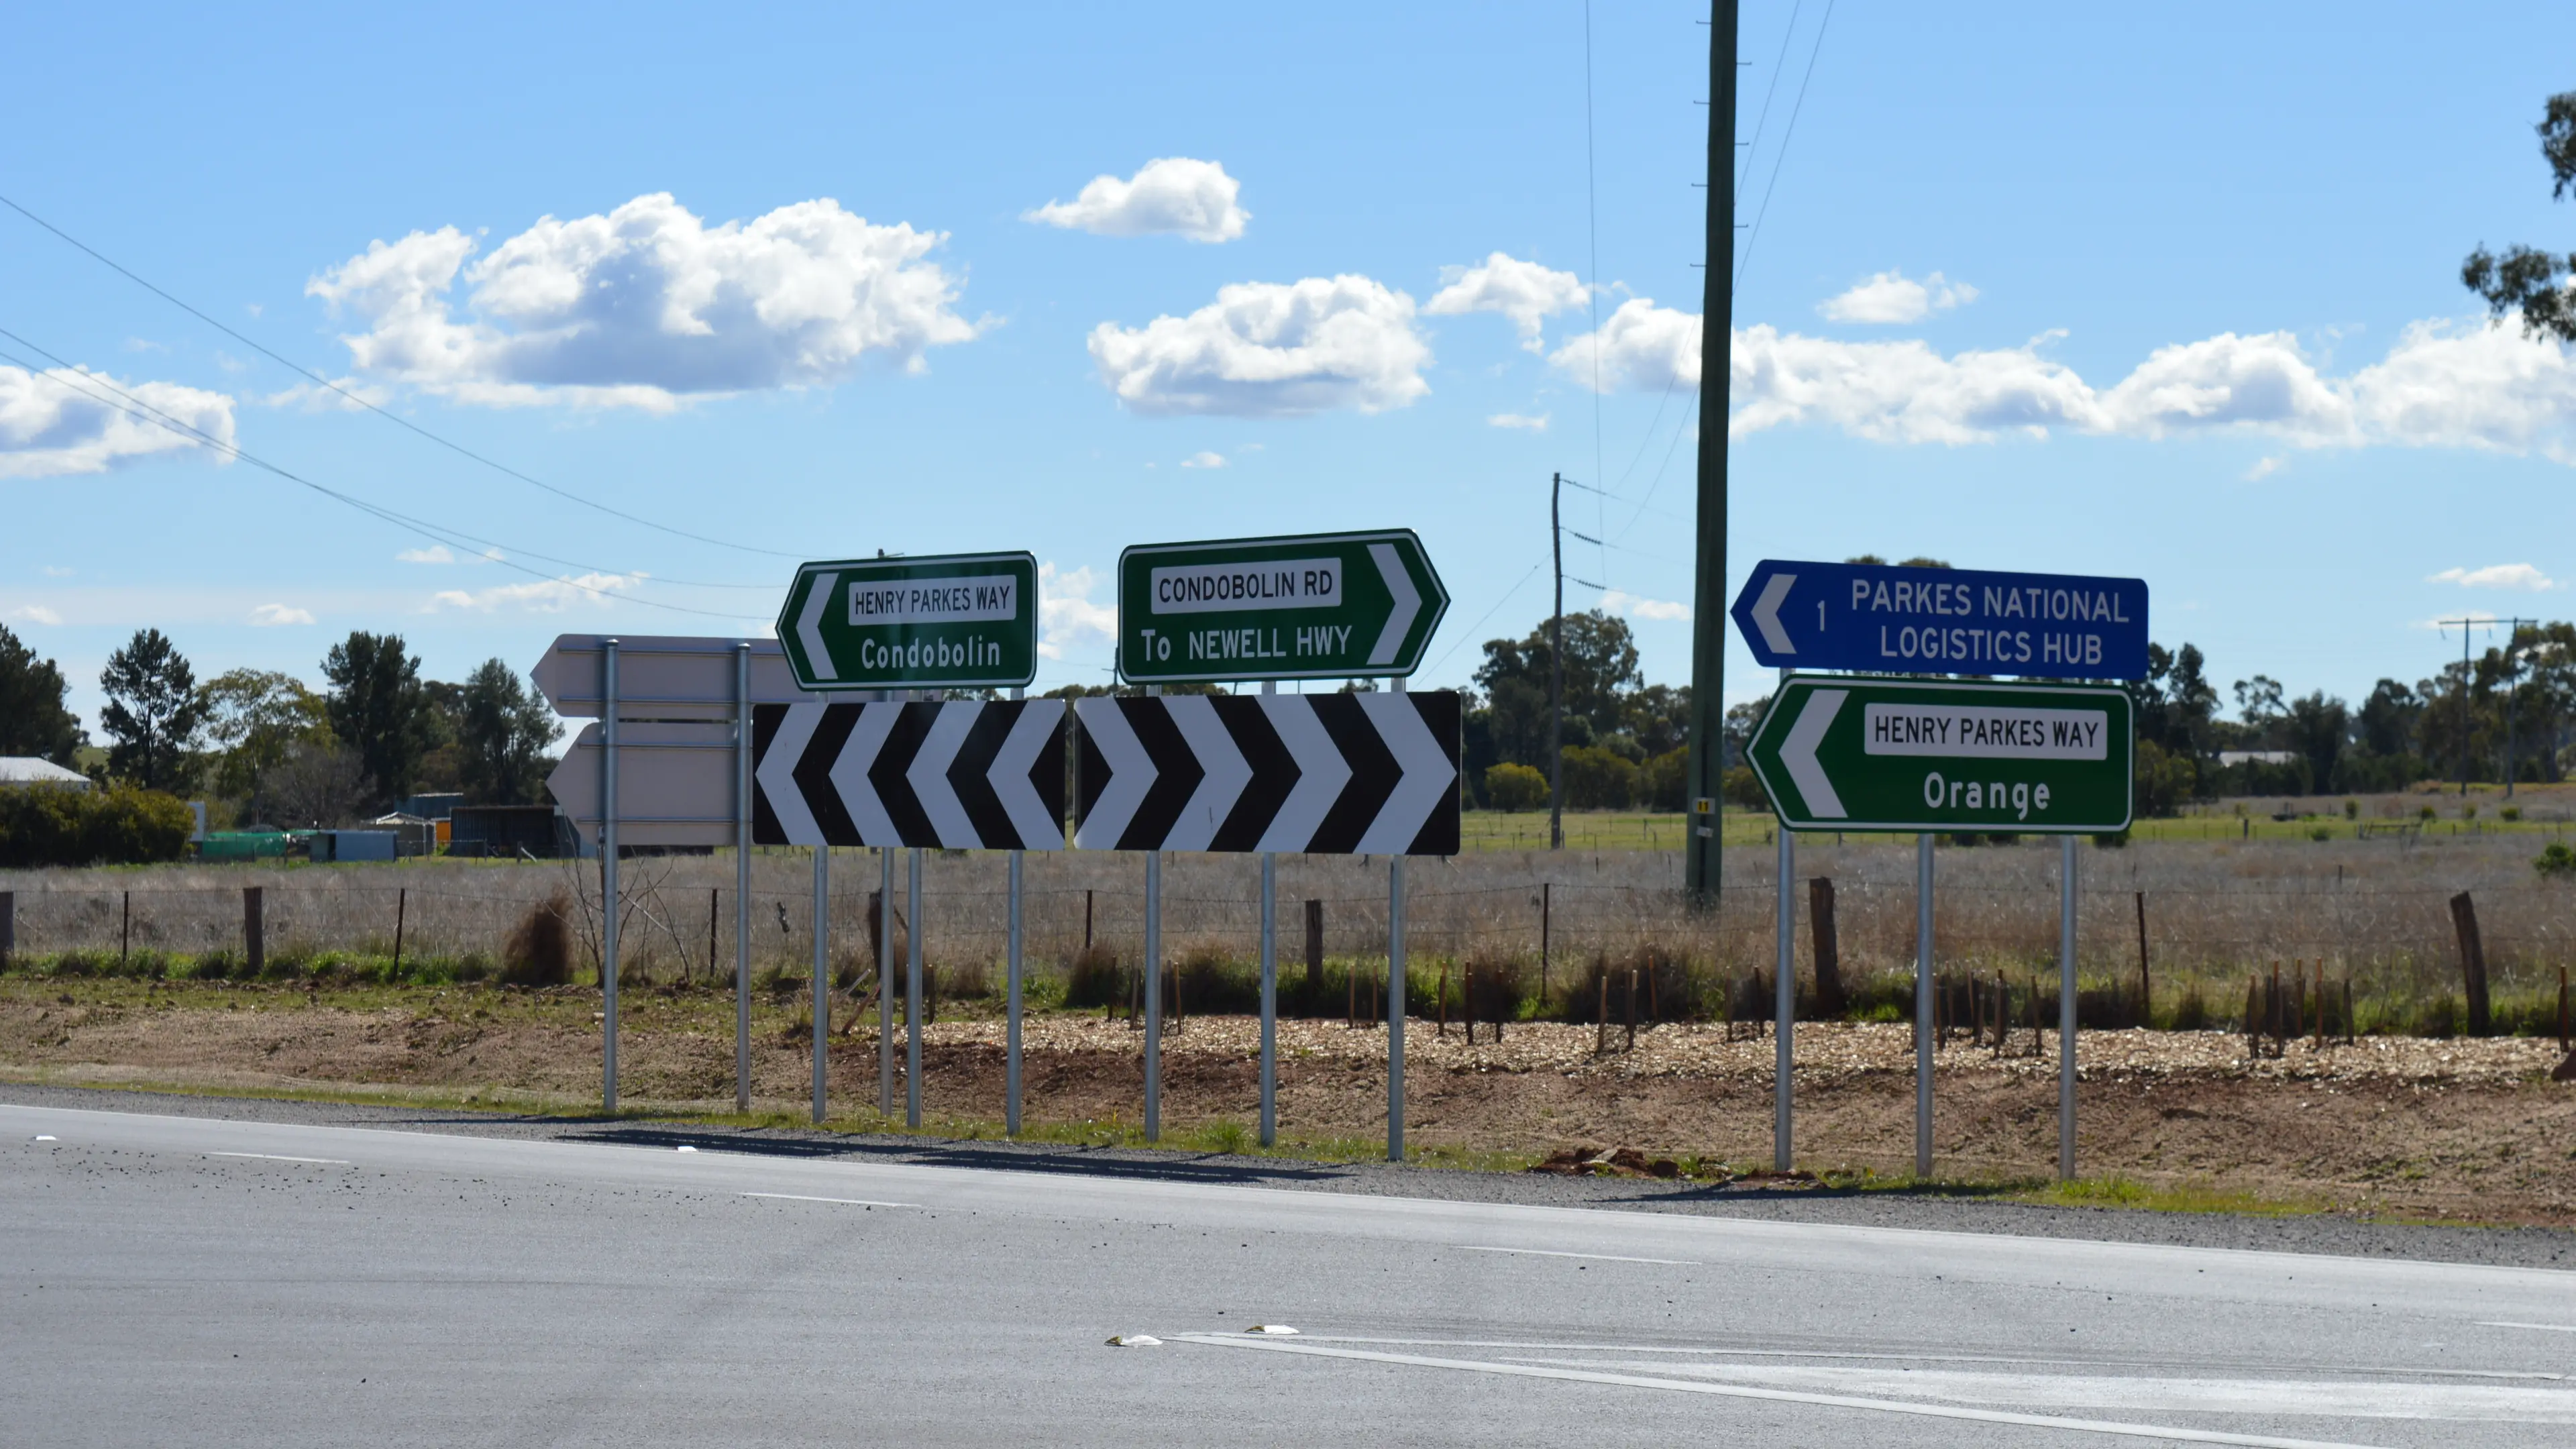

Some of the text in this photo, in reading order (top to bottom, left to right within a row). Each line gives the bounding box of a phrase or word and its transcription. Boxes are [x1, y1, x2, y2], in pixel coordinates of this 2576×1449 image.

[856, 586, 1010, 614] HENRY PARKES WAY
[1159, 570, 1332, 603] CONDOBOLIN RD
[1852, 579, 2129, 623] PARKES NATIONAL
[1817, 600, 1825, 632] 1
[862, 635, 1000, 669] Condobolin
[1141, 625, 1352, 661] To NEWELL HWY
[1881, 625, 2102, 665] LOGISTICS HUB
[1875, 715, 2098, 747] HENRY PARKES WAY
[1924, 771, 2050, 820] Orange
